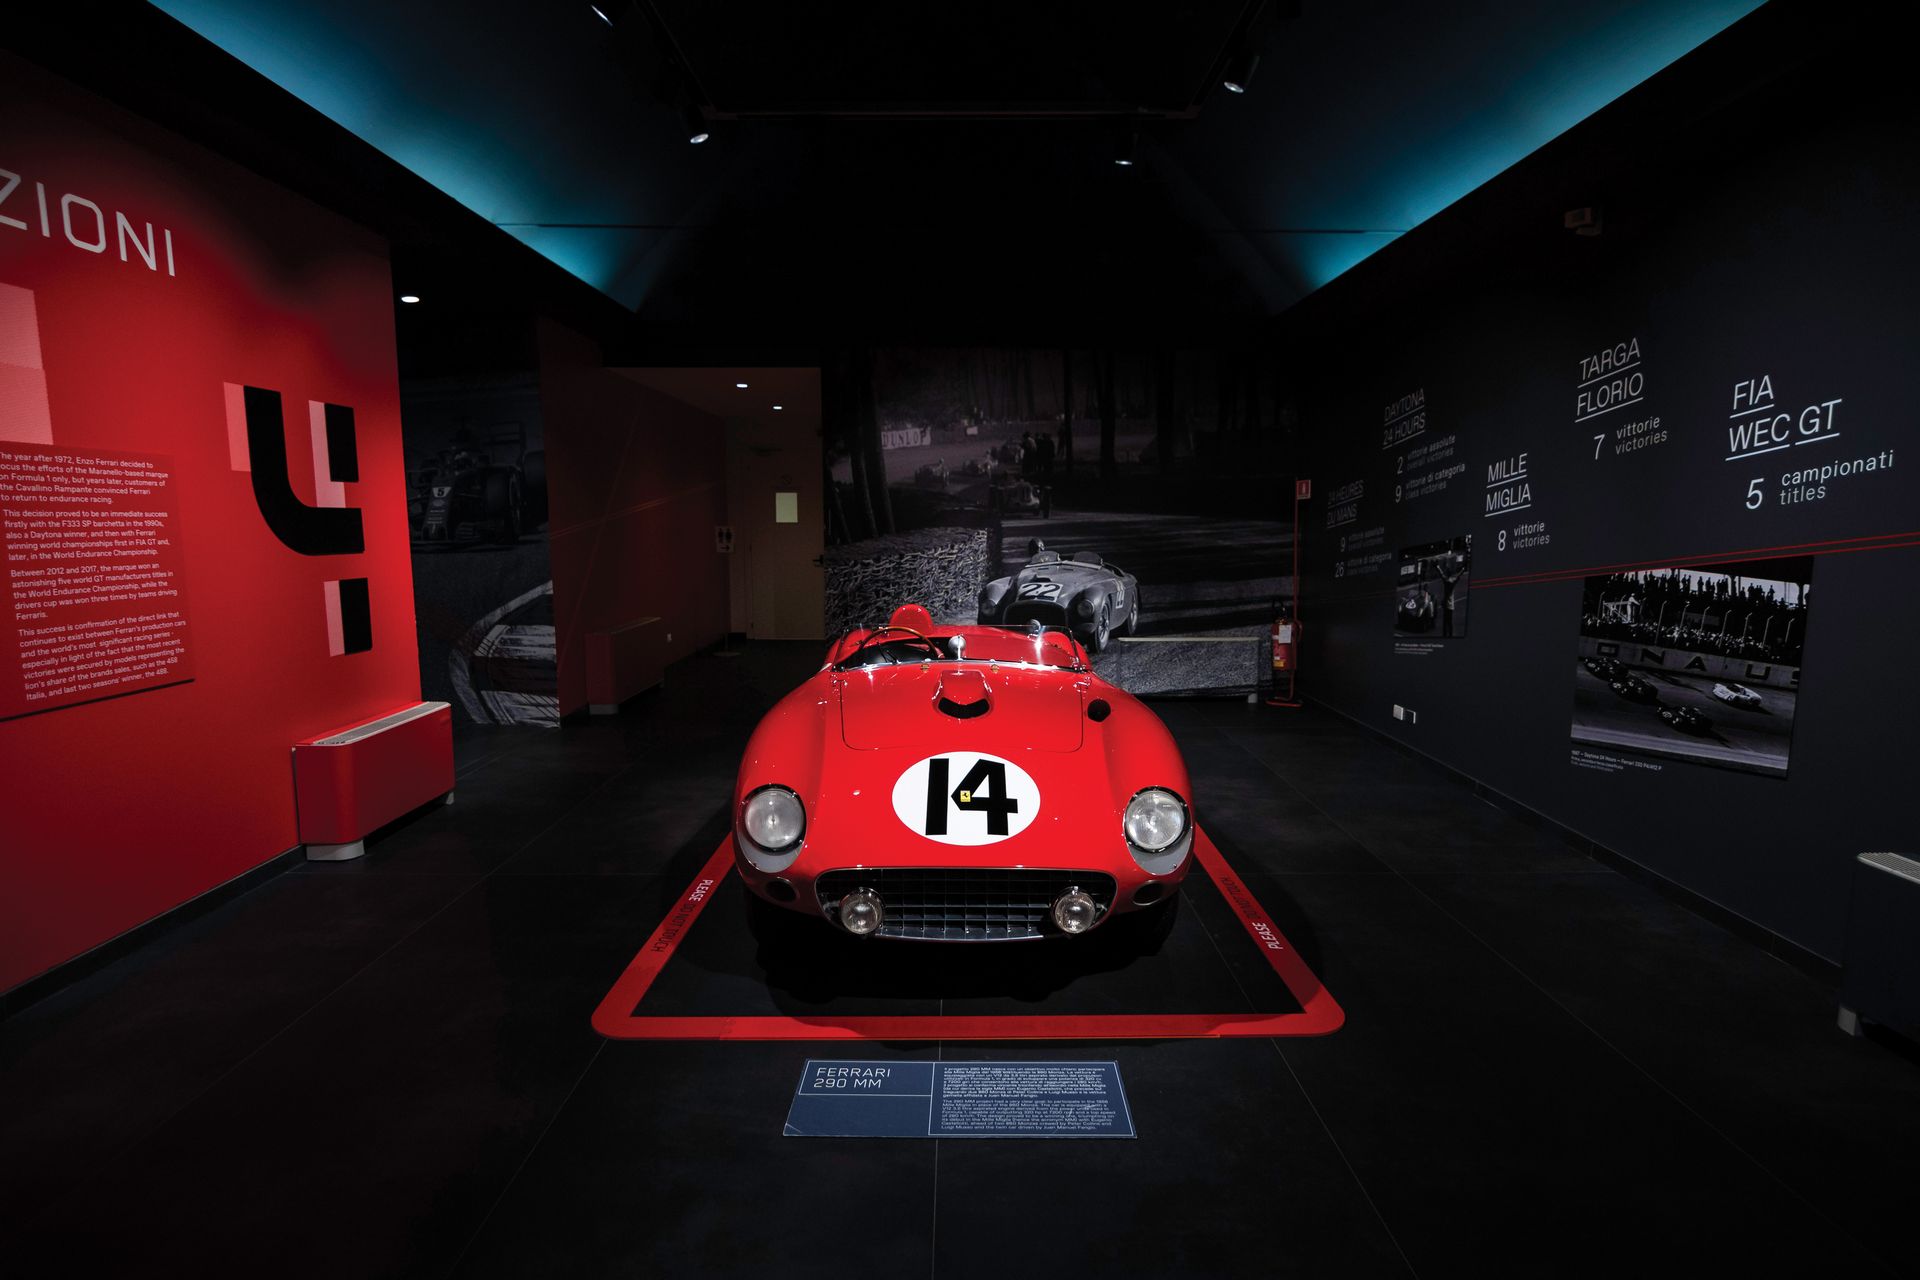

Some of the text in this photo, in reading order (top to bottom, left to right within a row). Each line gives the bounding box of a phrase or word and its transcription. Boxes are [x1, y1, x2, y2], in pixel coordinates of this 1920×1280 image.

[1580, 338, 1640, 380] TARGA
[1577, 372, 1644, 416] FLORIO
[1733, 374, 1774, 410] FIA
[1384, 388, 1424, 422] DAYTONA
[1384, 412, 1426, 446] 24 HOURS
[1616, 416, 1660, 440] vittorie
[1729, 398, 1842, 452] WEC GT
[1594, 434, 1605, 460] 7
[1616, 430, 1668, 455] victories
[1397, 456, 1404, 474] 2
[1434, 463, 1466, 479] categoria
[1488, 452, 1528, 482] MILLE
[1782, 450, 1894, 486] campionati
[1396, 485, 1402, 503] 9
[1486, 483, 1531, 512] MIGLIA
[1746, 478, 1764, 510] 5
[1780, 485, 1826, 505] titles
[1498, 530, 1506, 552] 8
[1514, 521, 1545, 536] vittorie
[1512, 534, 1550, 550] victories
[1020, 584, 1060, 601] 22
[925, 758, 1018, 836] 14
[688, 880, 714, 902] PLEASE
[1252, 922, 1284, 950] PLEASE
[814, 1078, 882, 1088] 290 MM
[816, 1068, 891, 1078] FERRARI
